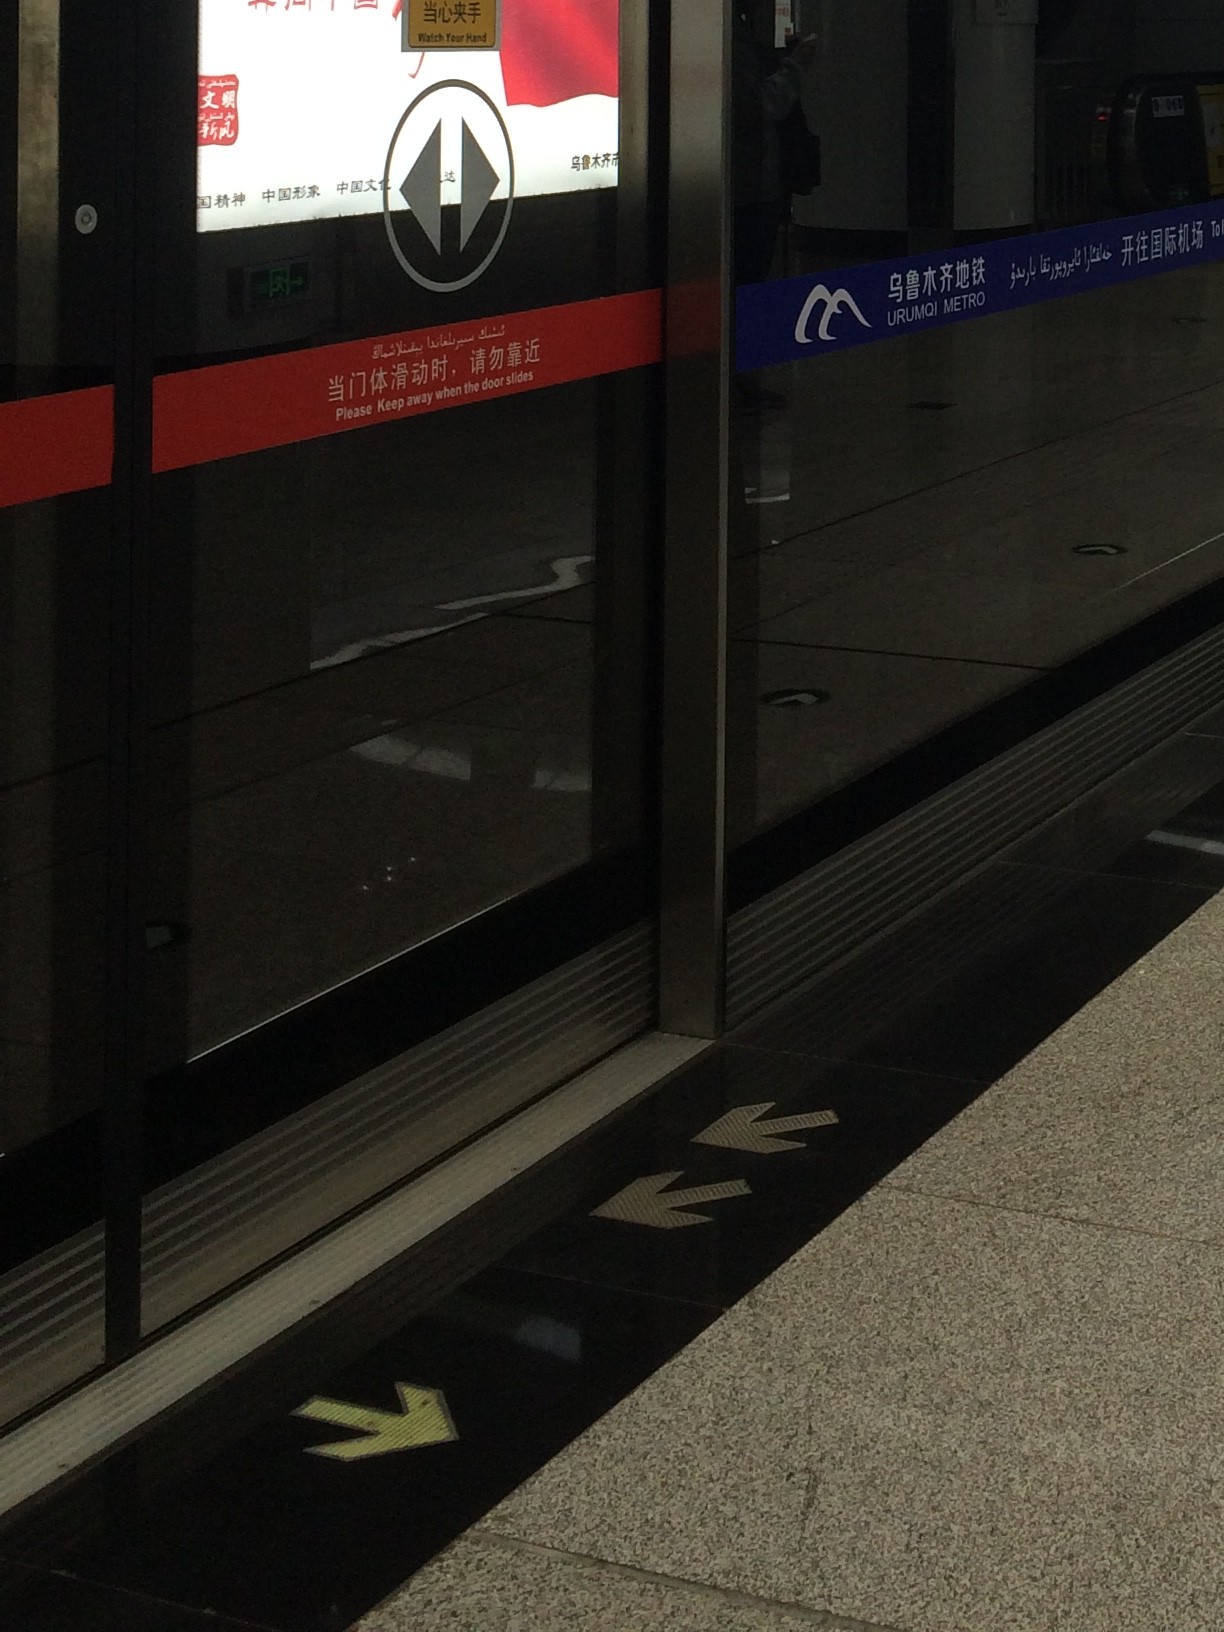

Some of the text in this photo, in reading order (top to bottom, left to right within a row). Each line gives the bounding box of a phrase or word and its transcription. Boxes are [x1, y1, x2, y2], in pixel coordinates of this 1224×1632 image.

[423, 0, 482, 25] 当心夹手
[418, 32, 487, 43] Watch Your Hand
[262, 185, 321, 204] 中国形象
[1121, 220, 1204, 267] 开往国际机场
[1210, 220, 1221, 239] To
[888, 256, 986, 303] 乌鲁木齐地铁
[887, 291, 986, 327] URUMQI METRO
[335, 369, 534, 422] Please Keep away when the door slides
